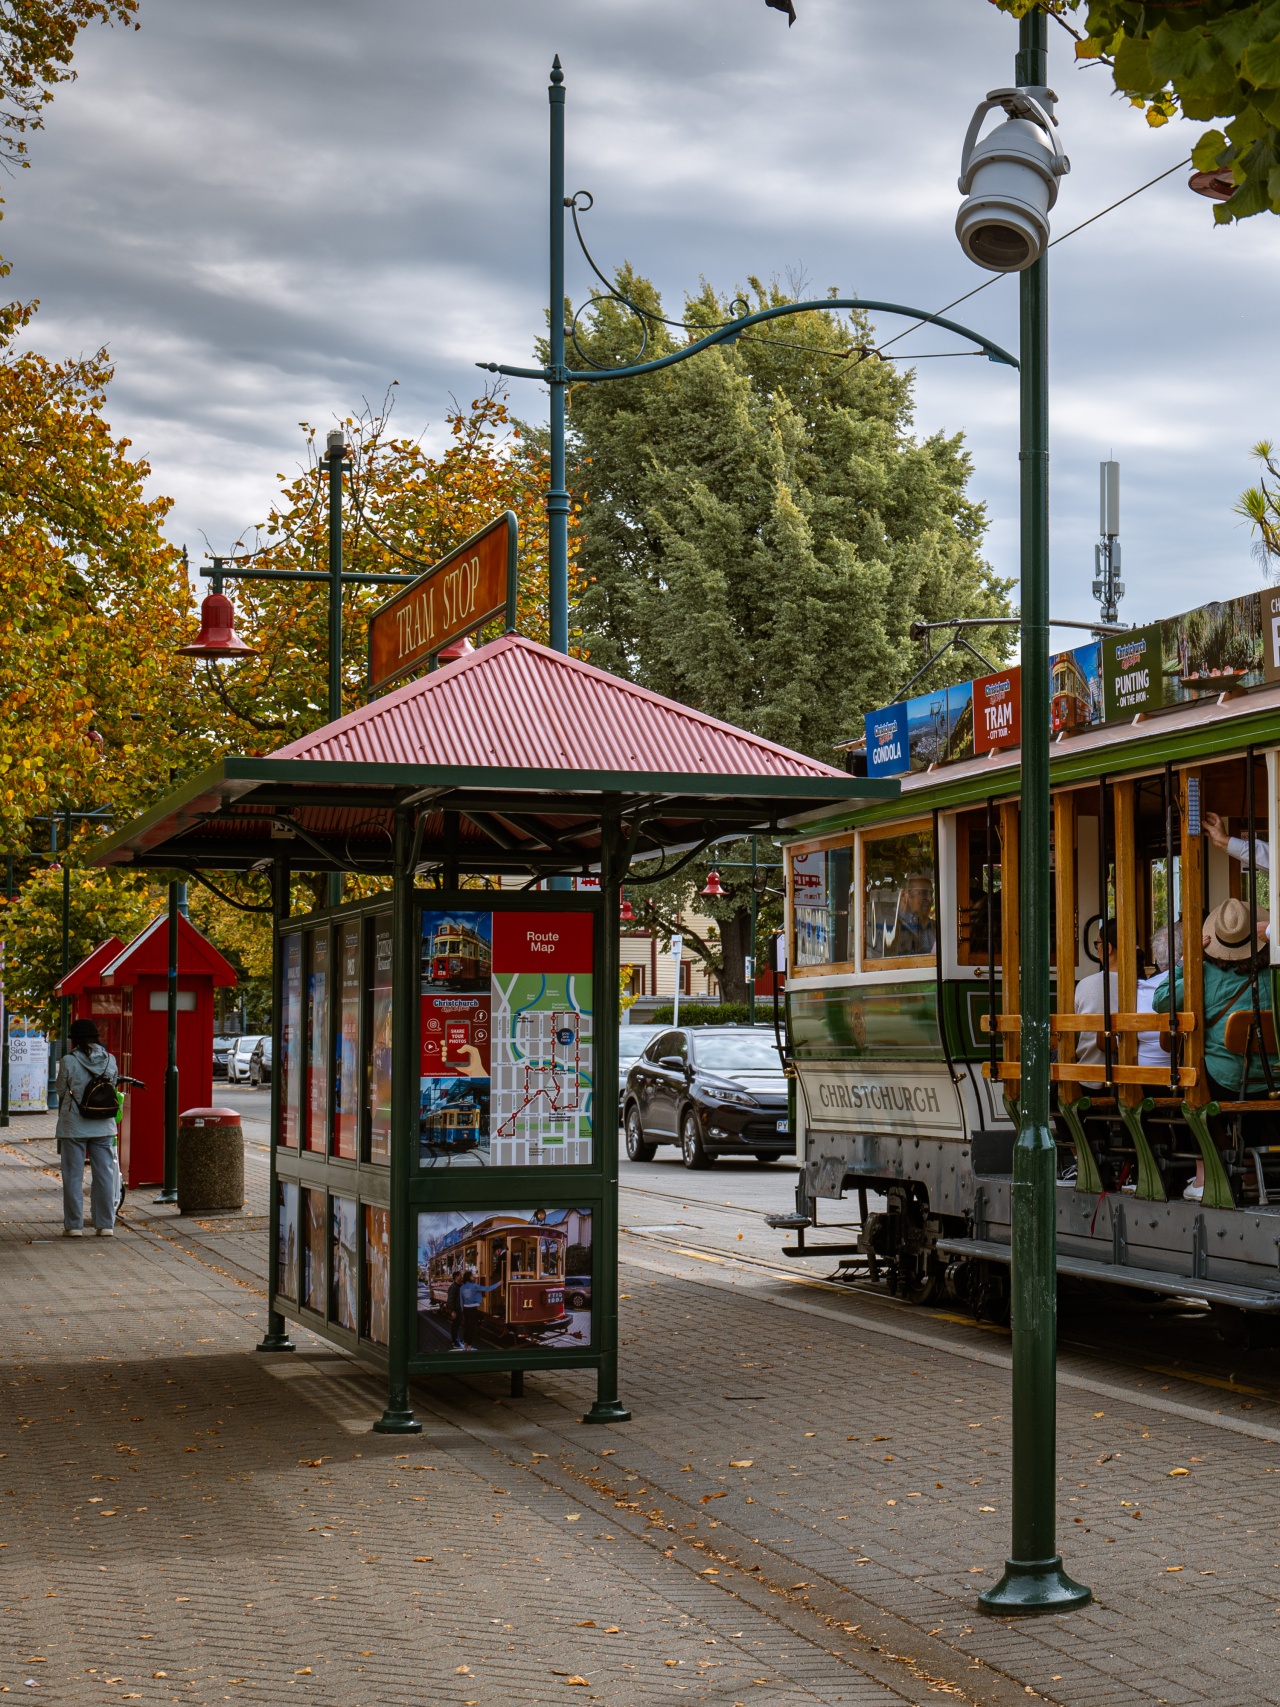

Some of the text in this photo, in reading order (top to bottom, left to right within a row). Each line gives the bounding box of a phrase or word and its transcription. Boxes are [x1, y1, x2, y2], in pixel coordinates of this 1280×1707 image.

[396, 556, 480, 659] TRAM STOP
[1115, 668, 1149, 696] PUNTING
[1120, 696, 1126, 707] ON
[1127, 694, 1135, 705] THE
[985, 702, 1012, 730] TRAM
[998, 727, 1008, 738] TOUR
[873, 742, 901, 764] GONDOLA
[526, 932, 559, 941] Route
[531, 942, 555, 953] Map
[433, 999, 479, 1008] Christchurch
[14, 1039, 26, 1047] Go
[10, 1046, 27, 1054] Side
[819, 1084, 941, 1113] CHRISTCHURCH
